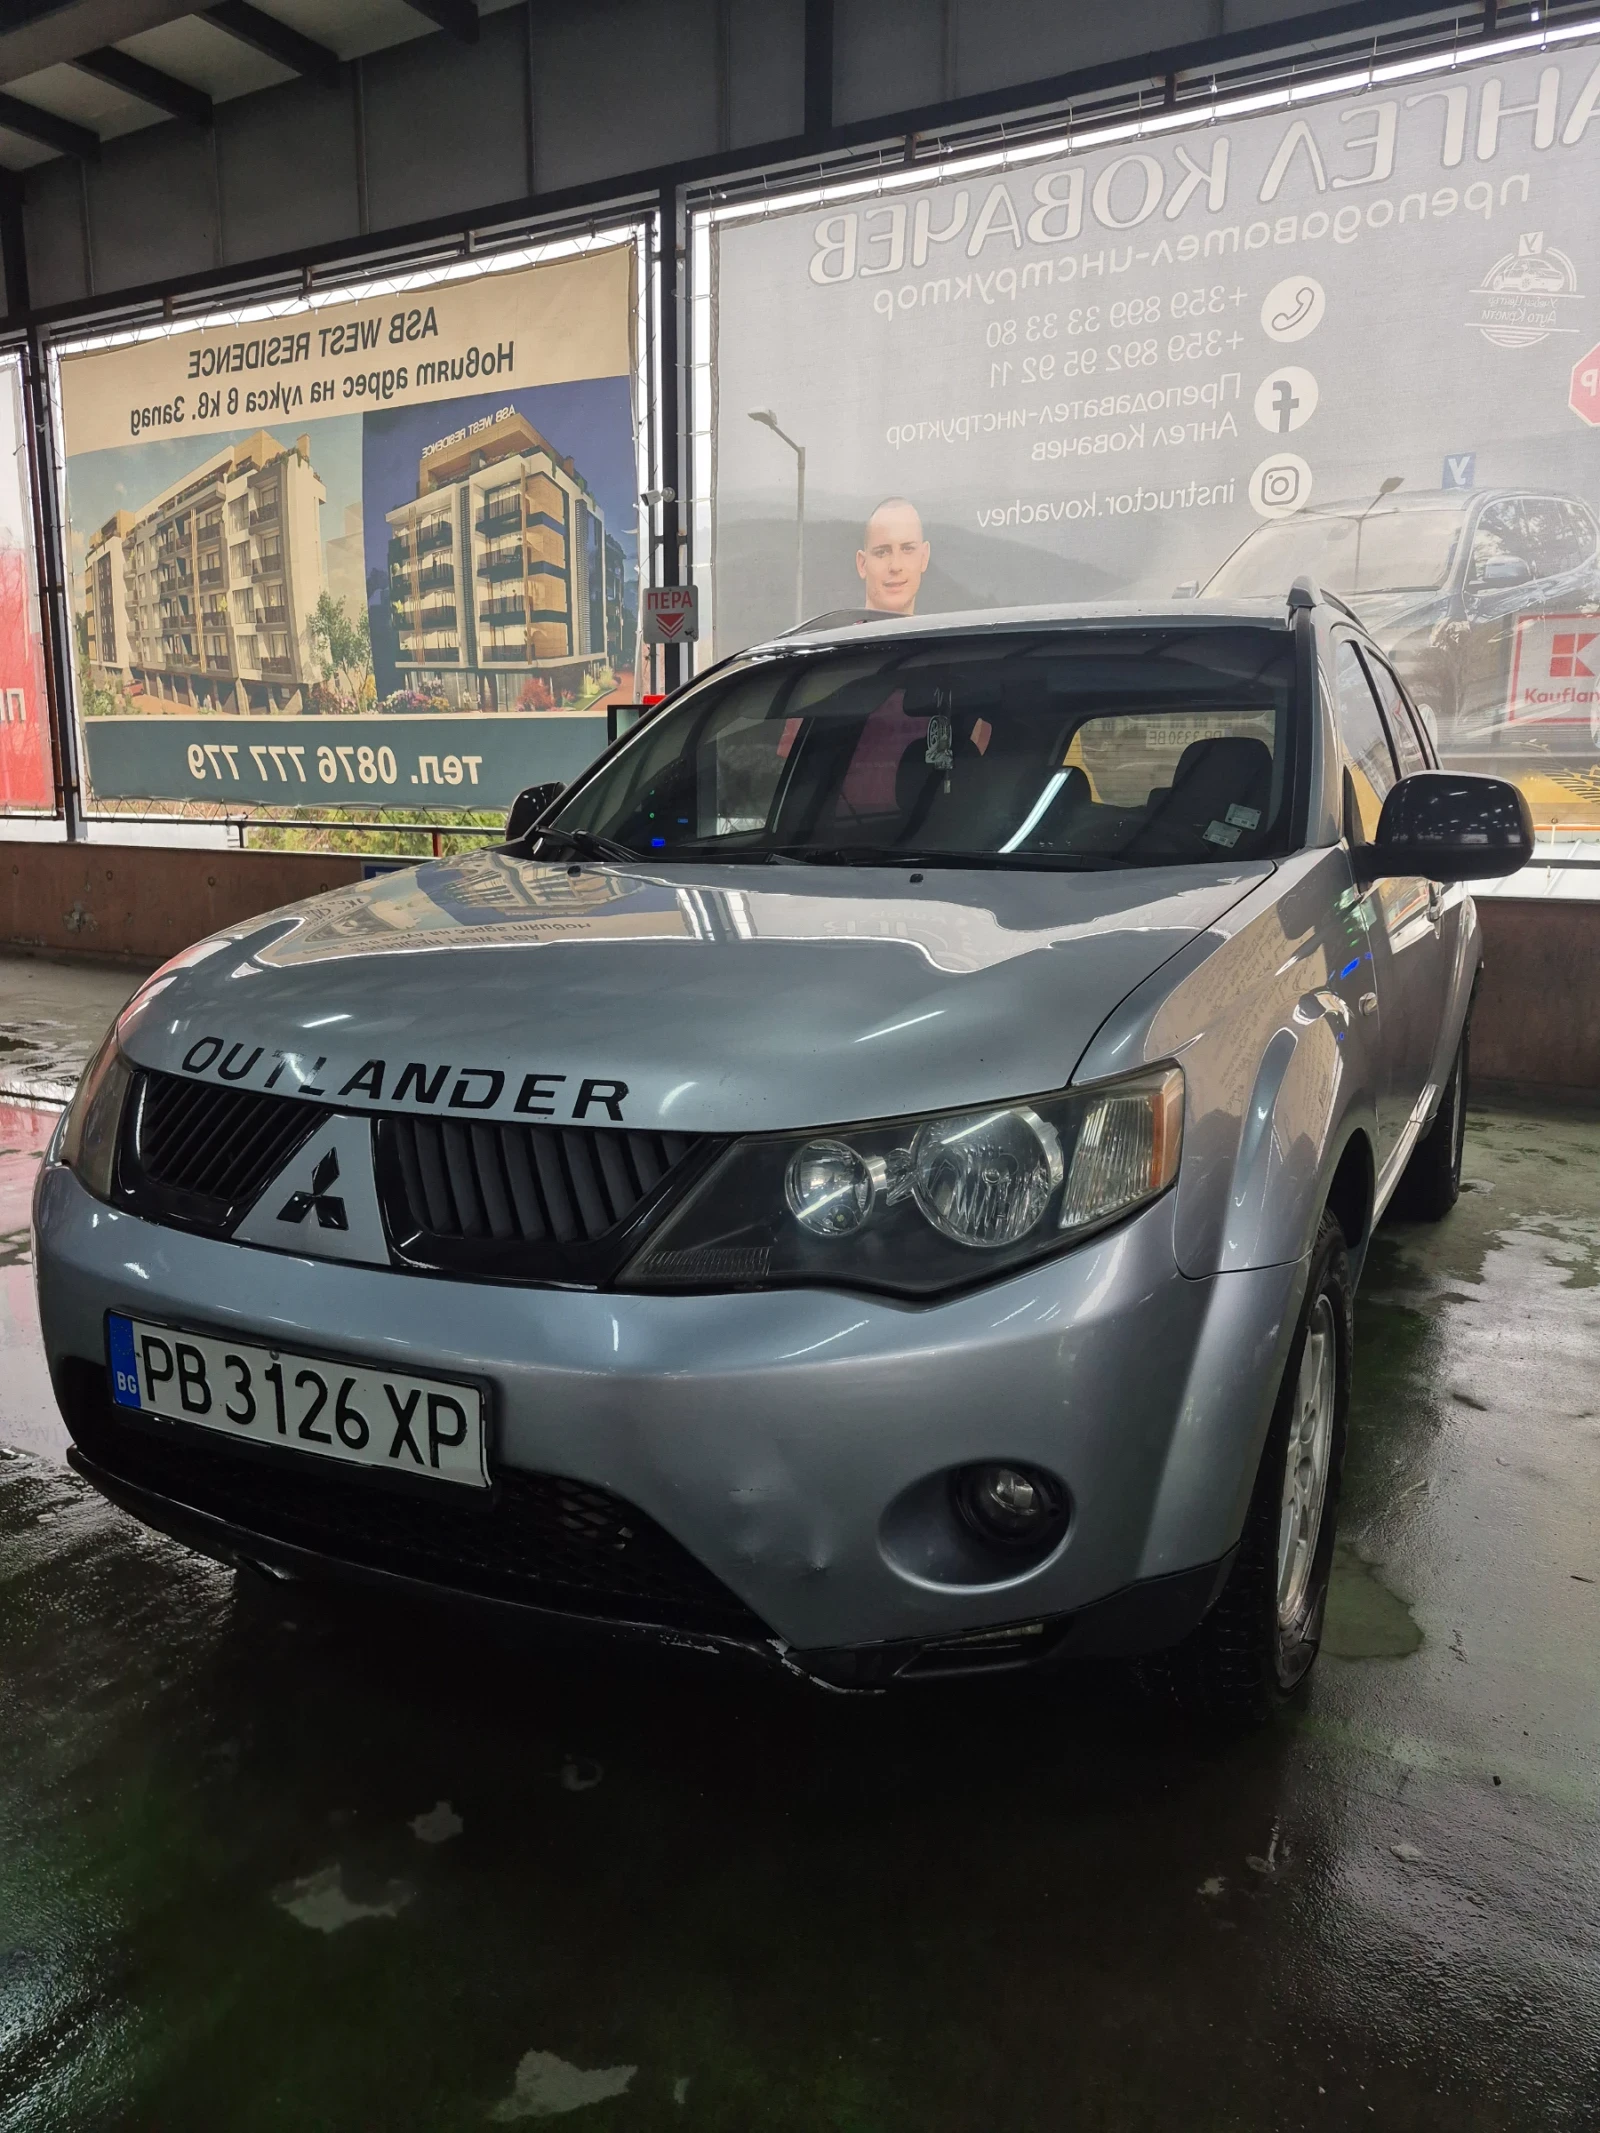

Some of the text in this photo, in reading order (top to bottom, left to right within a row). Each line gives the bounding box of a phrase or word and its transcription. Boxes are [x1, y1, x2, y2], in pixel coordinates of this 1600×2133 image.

[647, 590, 693, 610] ПЕРА
[181, 1036, 629, 1122] OUTLANDER
[116, 1371, 138, 1395] BG
[141, 1334, 468, 1469] PB 3126 XP
